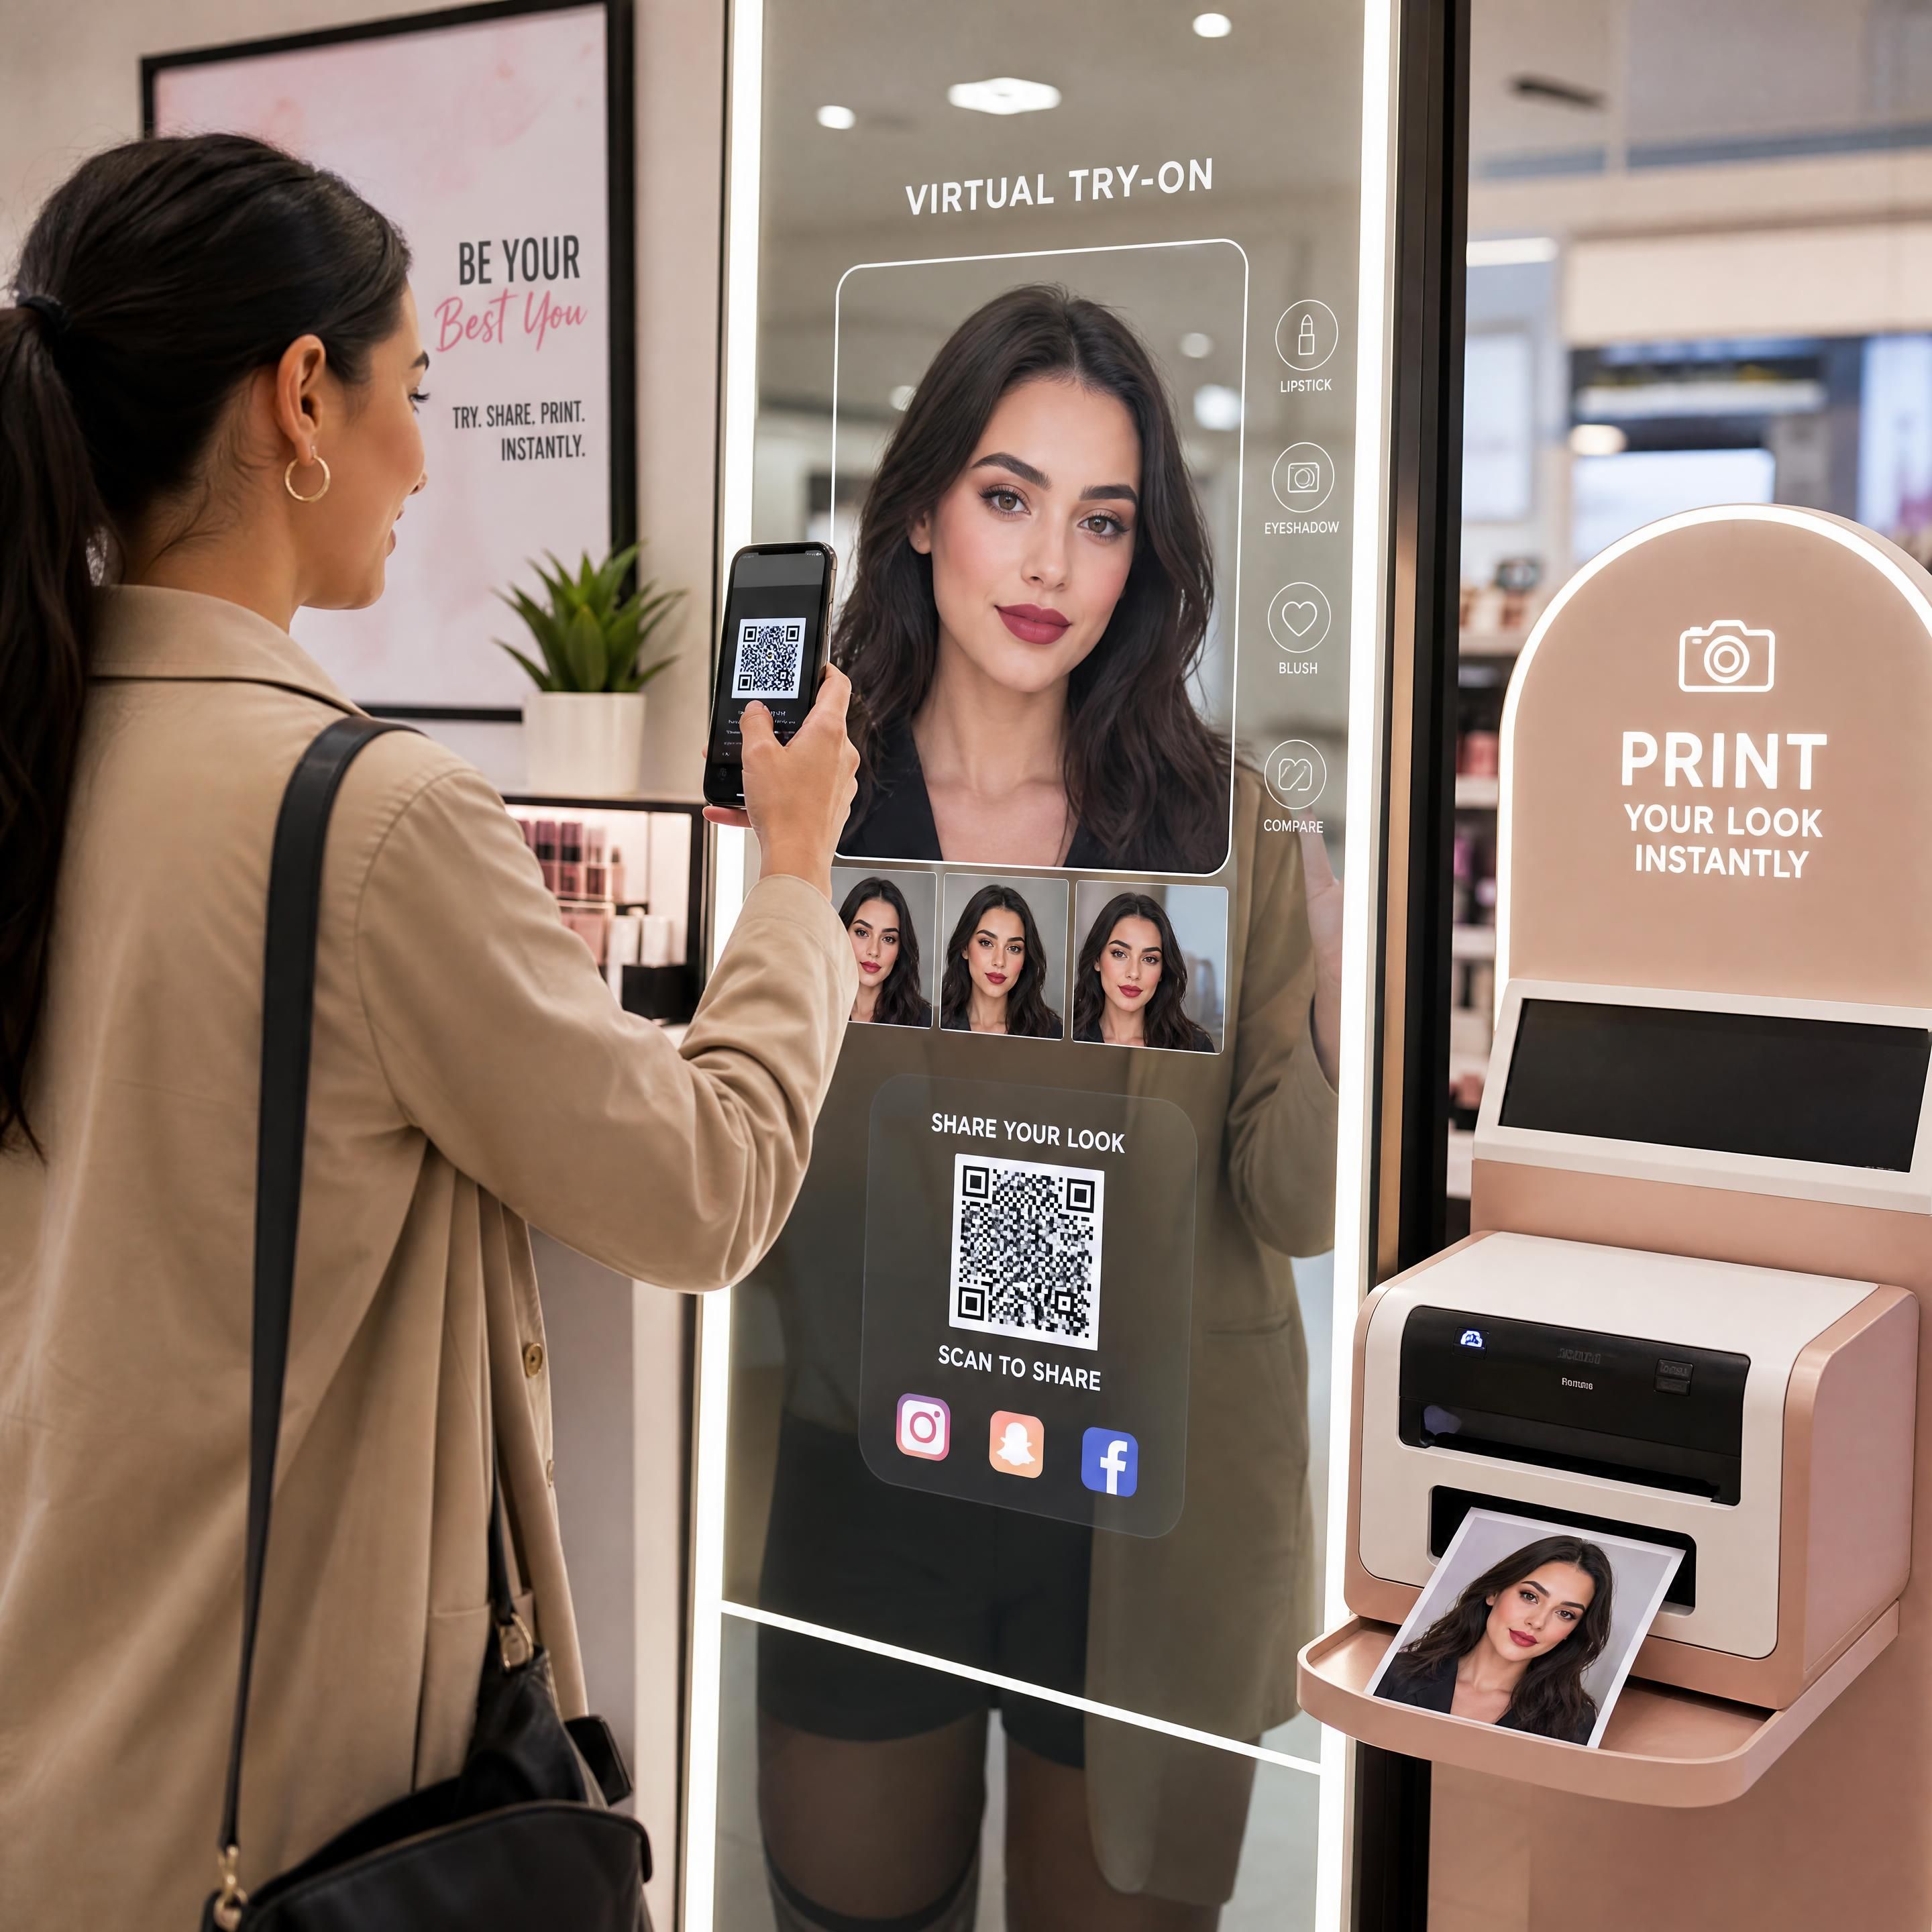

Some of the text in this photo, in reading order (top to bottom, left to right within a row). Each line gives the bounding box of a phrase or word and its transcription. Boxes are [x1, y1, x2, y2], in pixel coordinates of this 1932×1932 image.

[905, 158, 1212, 215] VIRTUAL TRY-ON
[459, 235, 580, 285] BE YOUR
[434, 288, 588, 352] Best You
[1280, 378, 1332, 392] LIPSTICK
[453, 400, 585, 429] TRY. SHARE. PRINT.
[502, 435, 585, 461] INSTANTLY.
[1265, 521, 1340, 535] EYESHADOW
[1279, 662, 1318, 674] BLUSH
[1621, 731, 1827, 790] PRINT
[1264, 818, 1324, 833] COMPARE
[1623, 804, 1823, 837] YOUR LOOK
[1635, 844, 1809, 878] INSTANTLY
[931, 1112, 1126, 1154] SHARE YOUR LOOK
[938, 1344, 1101, 1391] SCAN TO SHARE
